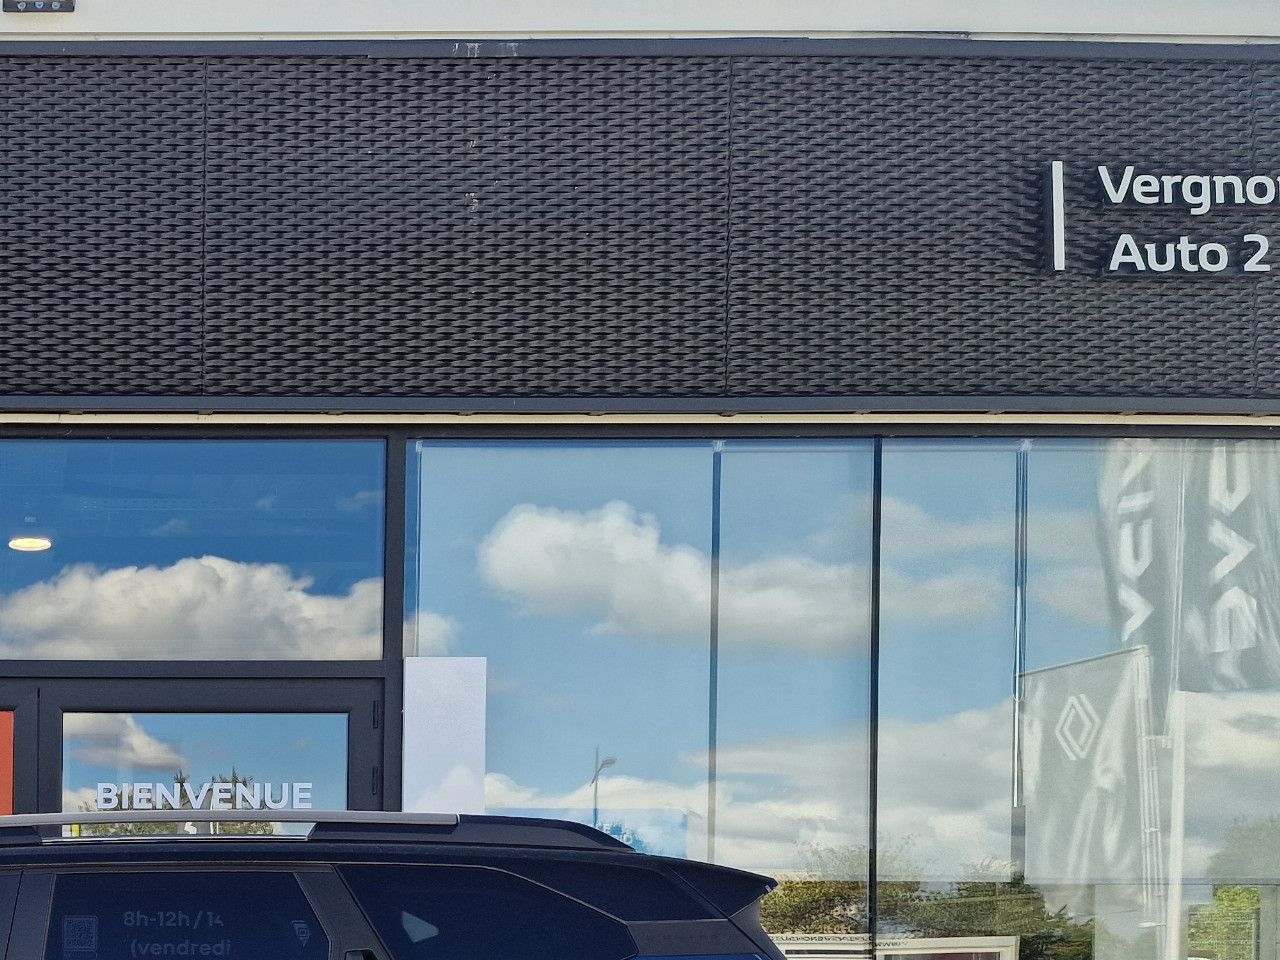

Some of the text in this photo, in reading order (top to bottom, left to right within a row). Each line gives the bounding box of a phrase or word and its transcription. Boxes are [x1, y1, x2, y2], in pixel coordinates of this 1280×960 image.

[1097, 166, 1280, 215] Vergno
[1108, 233, 1271, 272] Auto 2
[97, 782, 312, 809] BIENVENUE
[130, 939, 232, 958] (vendredi
